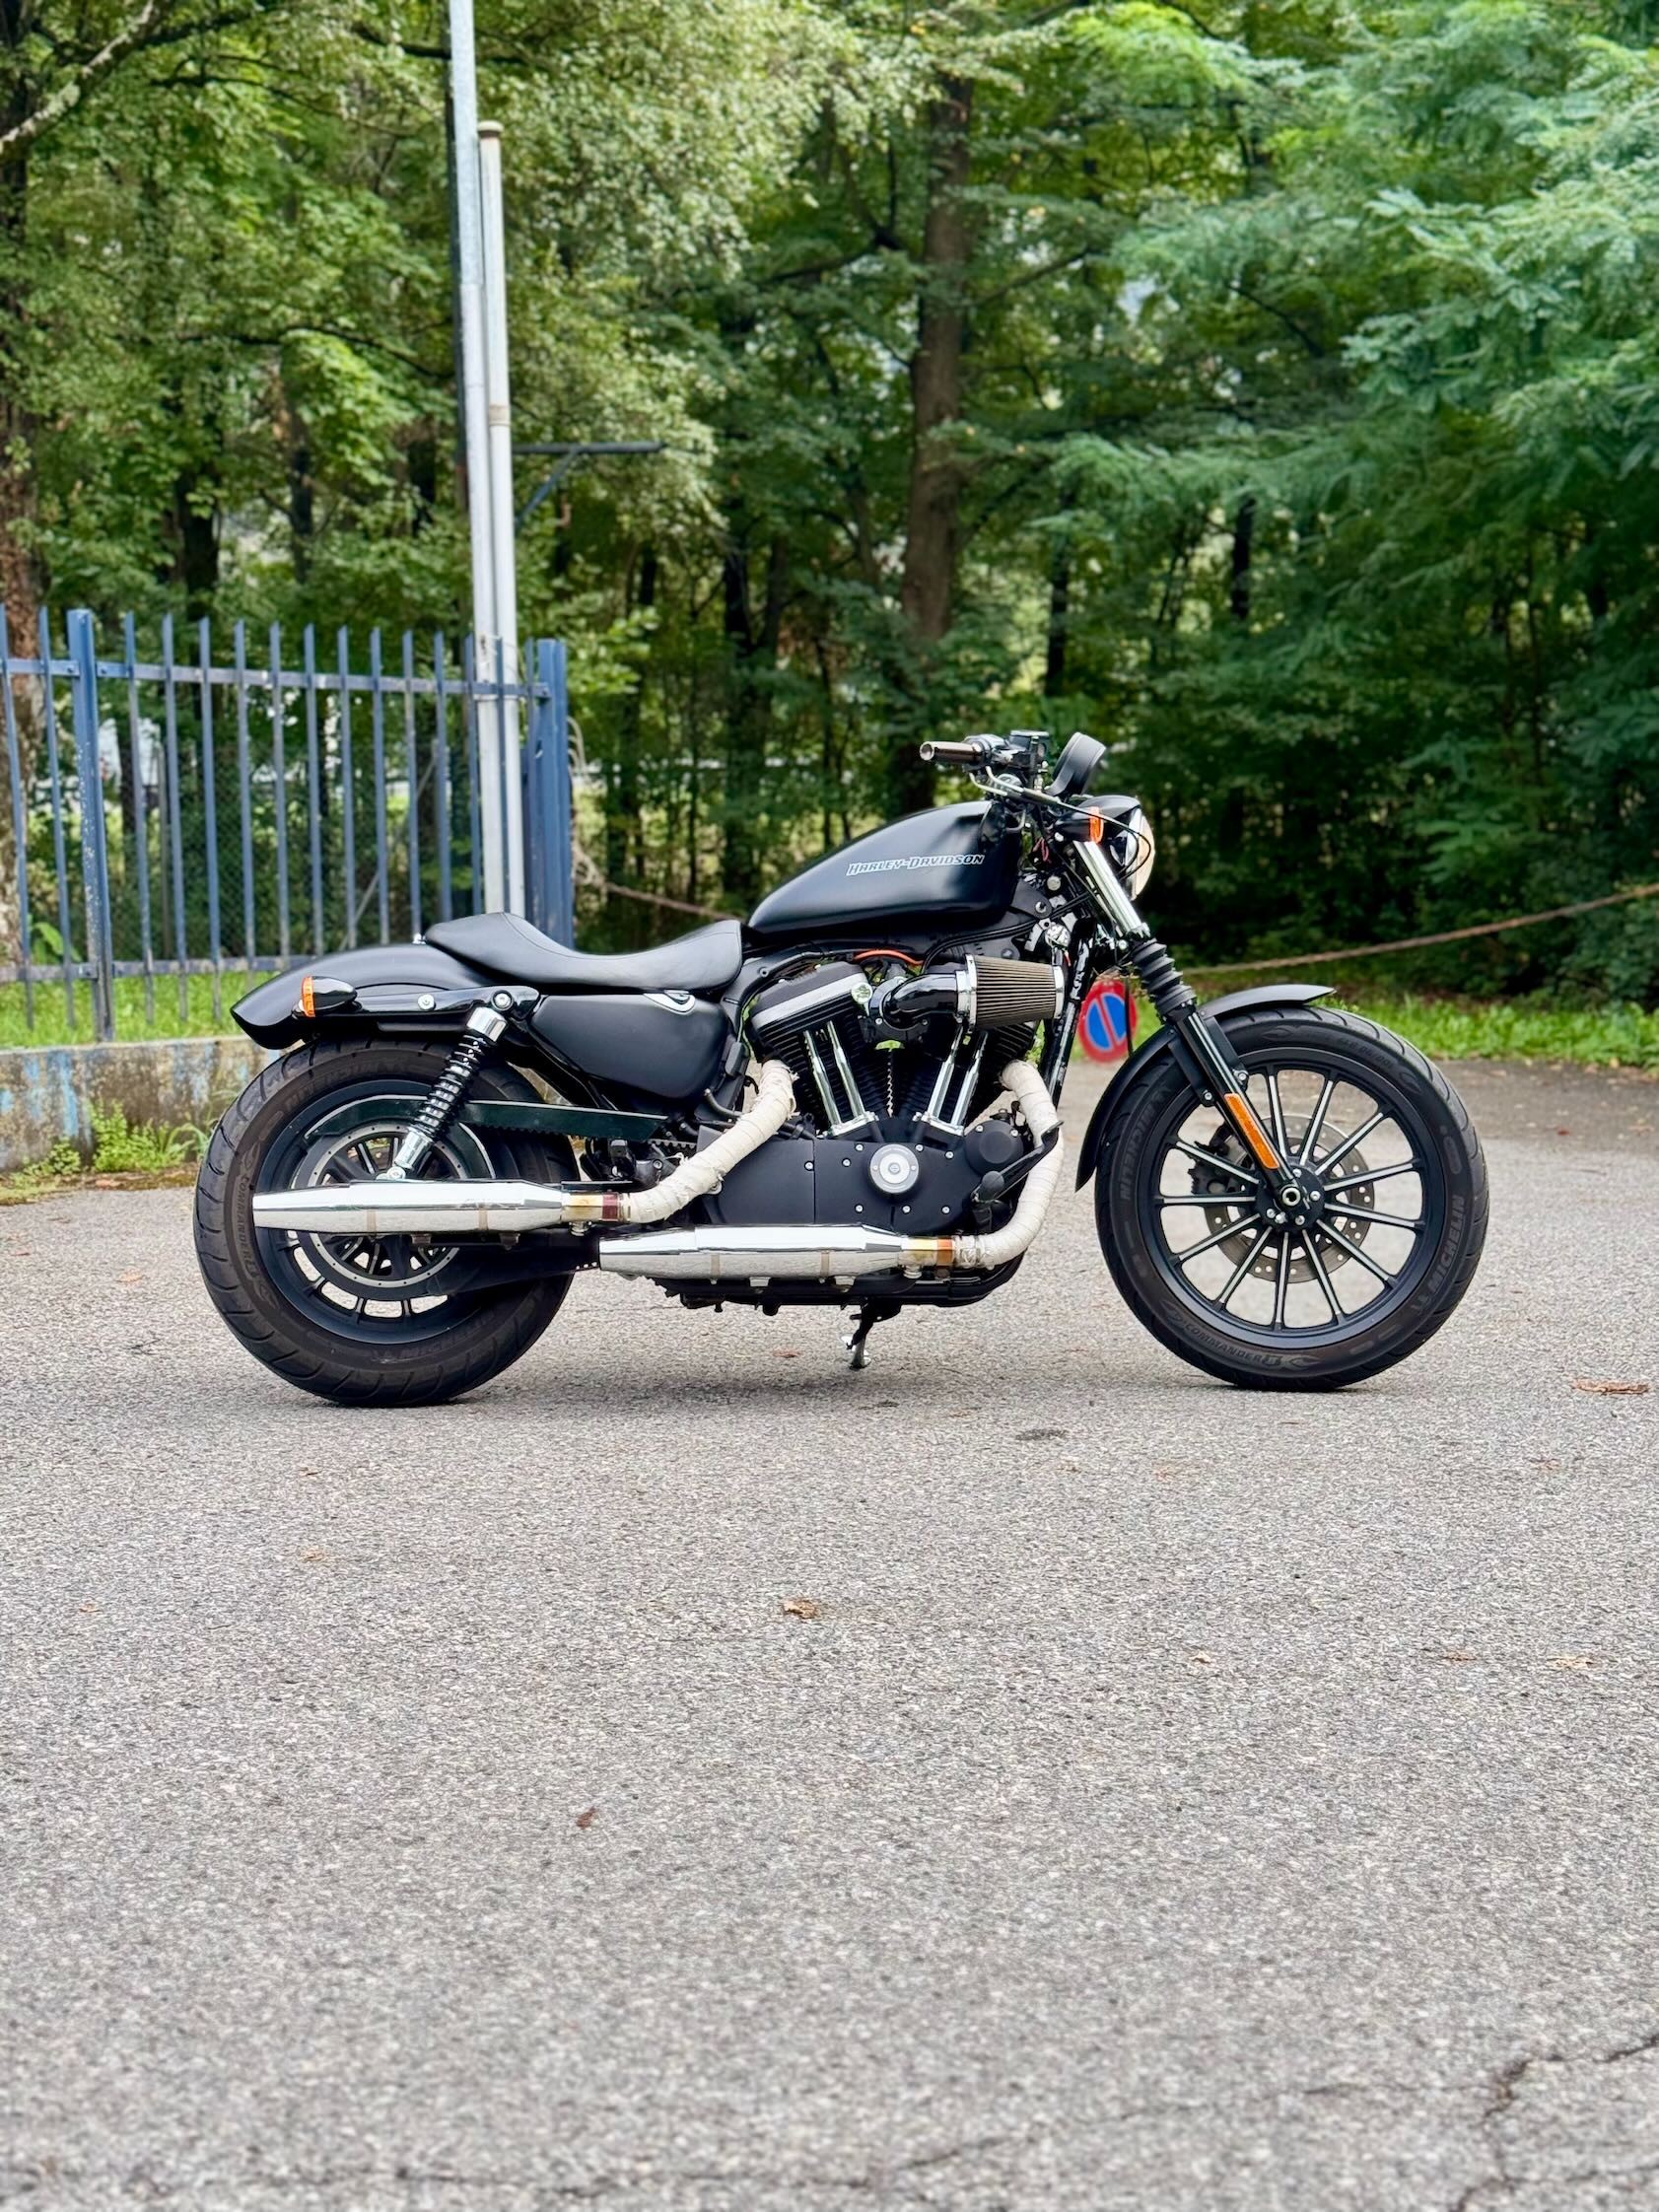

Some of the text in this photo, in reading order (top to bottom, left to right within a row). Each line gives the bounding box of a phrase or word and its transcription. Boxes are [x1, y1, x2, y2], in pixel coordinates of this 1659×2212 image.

[846, 855, 985, 875] HARLEY-DAVIDSON
[1119, 1103, 1157, 1200] MICHELIN
[236, 1173, 252, 1261] COMMANDER
[1426, 1194, 1465, 1292] MICHELIN
[1183, 1320, 1263, 1363] COMMANDER
